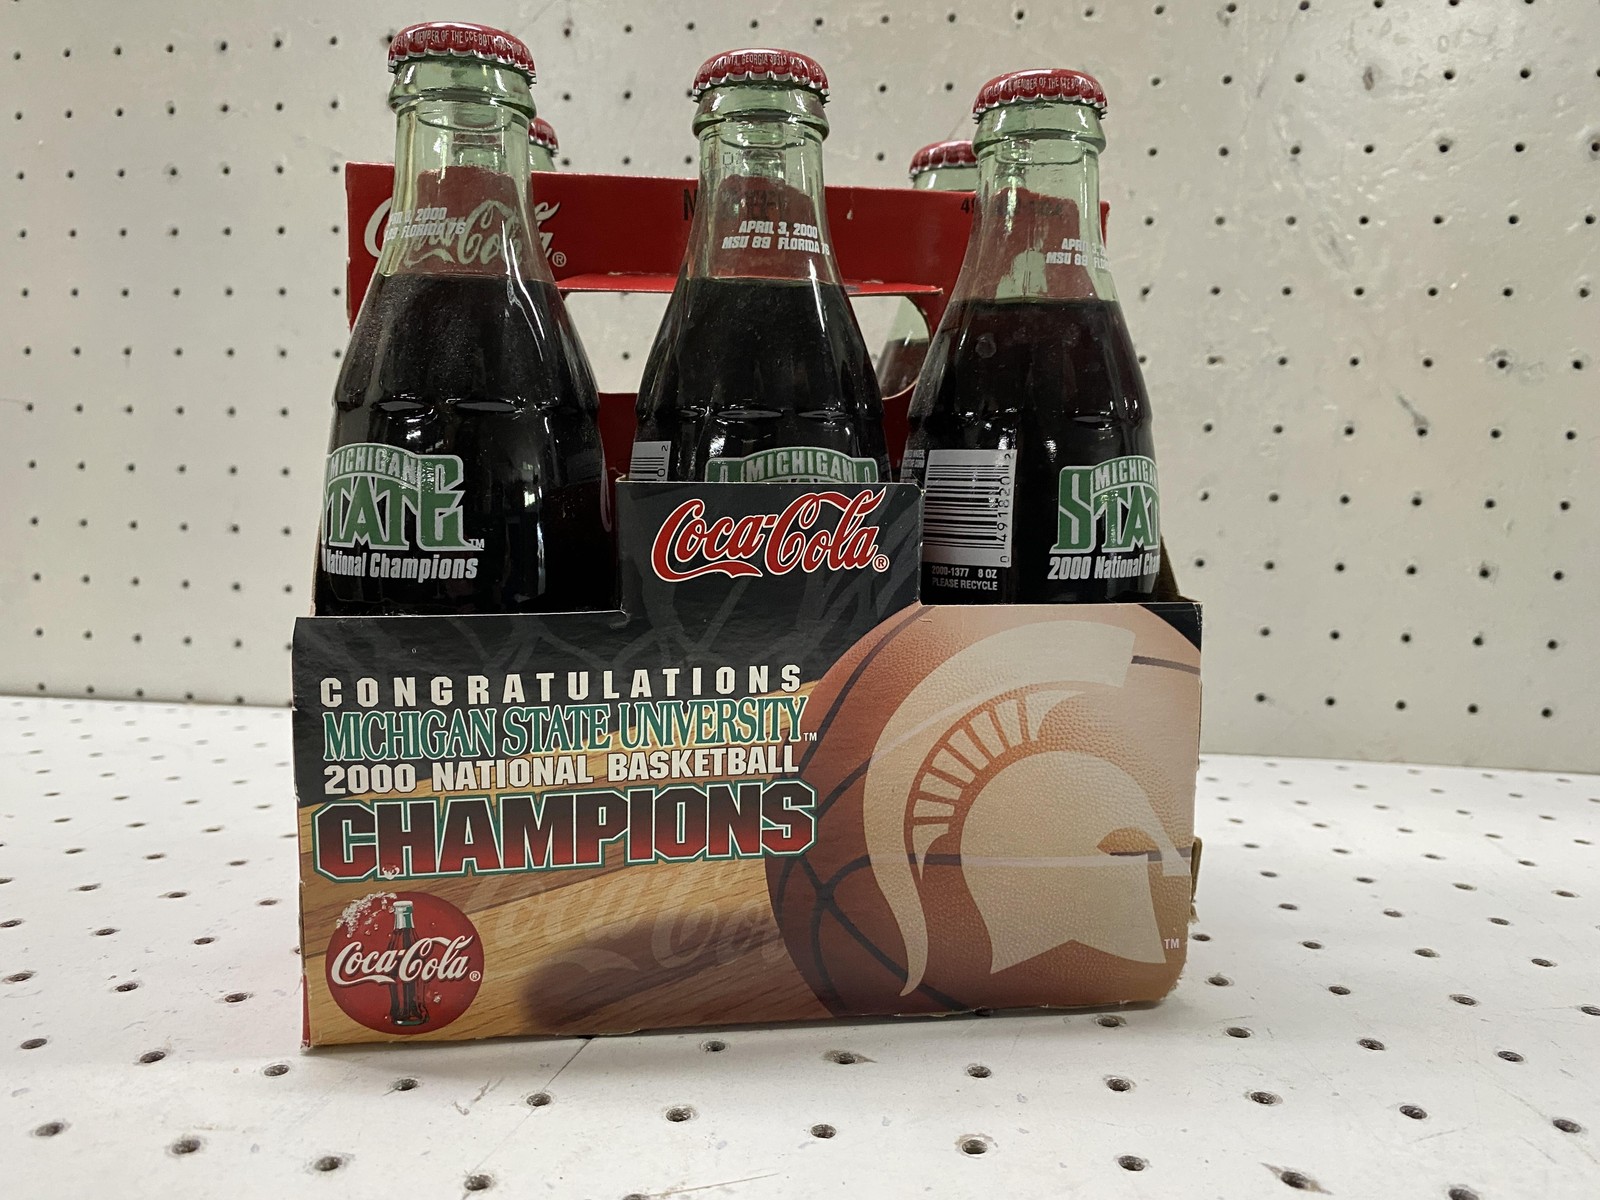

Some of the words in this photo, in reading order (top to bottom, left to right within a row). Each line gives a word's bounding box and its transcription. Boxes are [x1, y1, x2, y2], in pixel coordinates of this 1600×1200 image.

[451, 30, 463, 44] THE
[742, 53, 768, 65] GEORGIA
[416, 207, 448, 222] 2000
[738, 220, 774, 234] APRIL
[777, 221, 789, 237] 3,
[793, 222, 818, 239] 2000
[1061, 237, 1089, 251] APRIL
[721, 235, 750, 249] MSU
[777, 237, 820, 254] FLORIDA
[1045, 252, 1071, 265] MSU
[329, 446, 418, 486] MICHIGAN
[749, 450, 852, 483] MICHIGAN
[322, 454, 484, 551] TATE
[651, 485, 887, 583] Coca-Cola
[369, 552, 478, 583] Champions
[931, 565, 969, 578] 2000-1377
[978, 568, 984, 577] 8
[985, 568, 998, 579] OZ
[1047, 556, 1092, 580] 2000
[1094, 553, 1143, 579] National
[931, 577, 958, 589] PLEASE
[960, 578, 998, 591] RECYCLE
[320, 664, 801, 708] CONGRATULATIONS
[322, 708, 497, 761] MICHIGAN
[502, 703, 613, 756] STATE
[617, 696, 809, 749] UNIVERSITY
[324, 763, 417, 795] 2000
[432, 755, 594, 792] NATIONAL
[607, 745, 799, 782] BASKETBALL
[311, 780, 819, 884] CHAMPIONS
[331, 935, 474, 986] Coca-Cola
